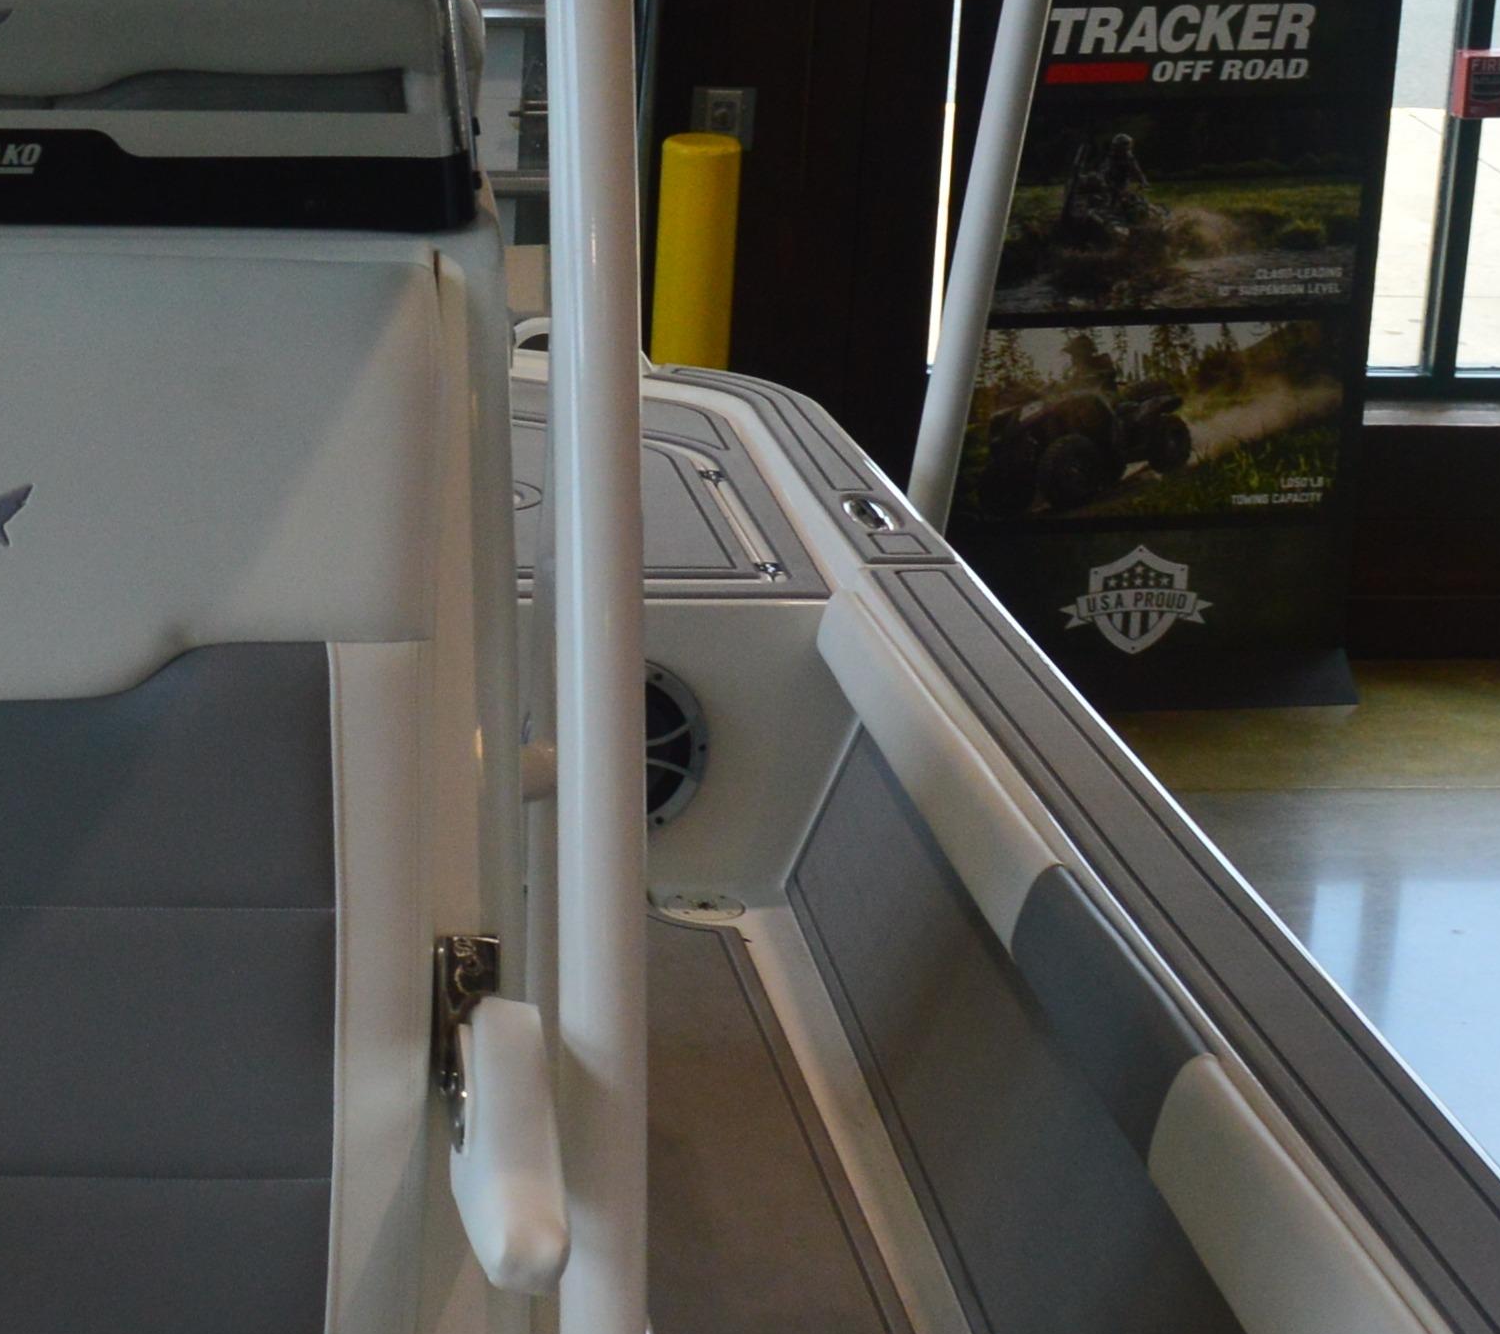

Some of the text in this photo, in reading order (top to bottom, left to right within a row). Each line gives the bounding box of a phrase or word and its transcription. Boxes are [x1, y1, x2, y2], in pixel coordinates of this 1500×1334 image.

[1048, 2, 1316, 56] TRACKER
[1151, 58, 1309, 83] OFF ROAD
[1086, 591, 1188, 613] USA PROUD
